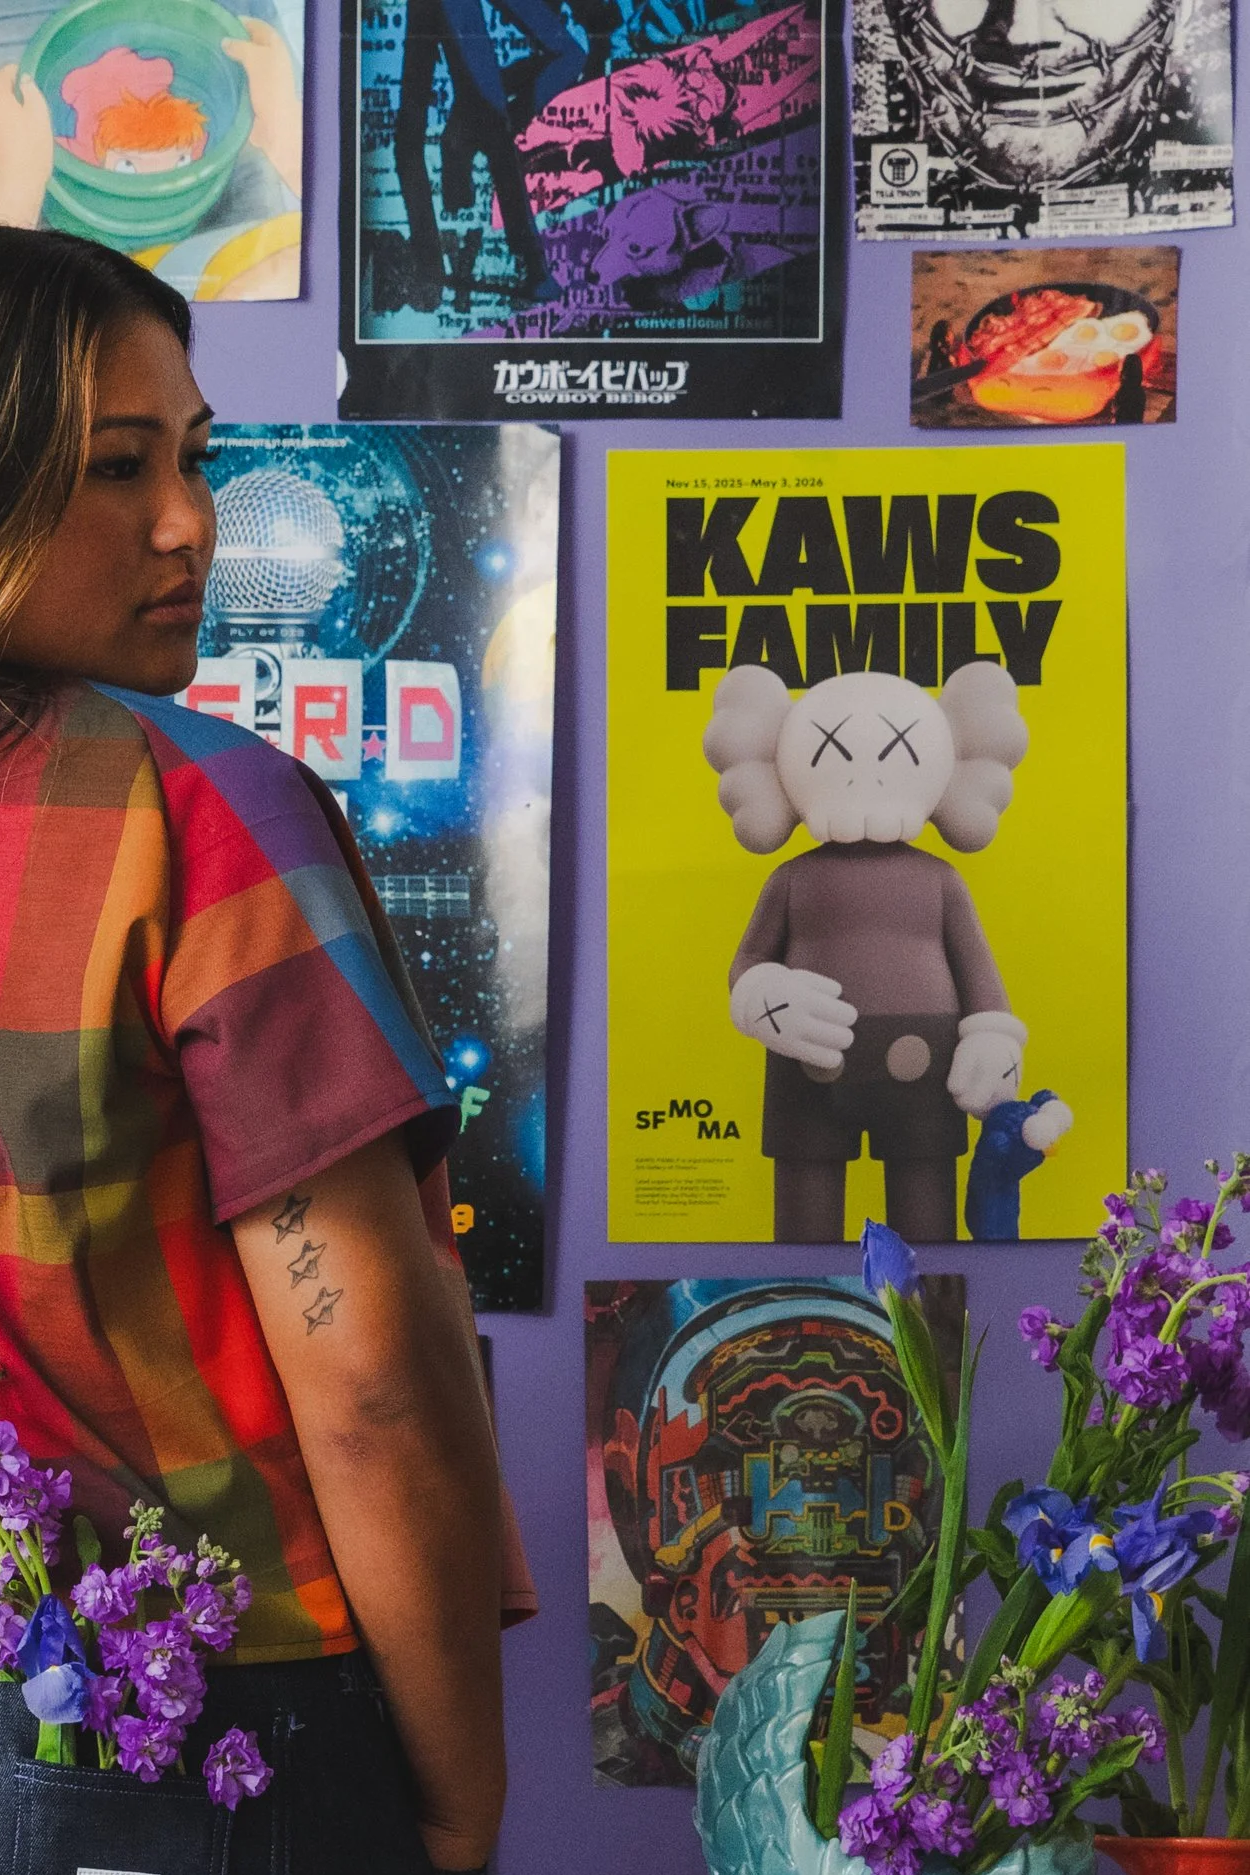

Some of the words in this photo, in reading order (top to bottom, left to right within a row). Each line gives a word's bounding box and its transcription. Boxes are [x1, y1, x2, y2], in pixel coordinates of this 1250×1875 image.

[494, 360, 689, 391] カウボーイビバップ
[505, 392, 600, 404] COWBOY
[605, 392, 677, 404] BEBOP
[666, 479, 689, 488] Nov
[795, 477, 824, 488] 2026
[667, 491, 1061, 597] KAWS
[667, 600, 1062, 691] FAMILY
